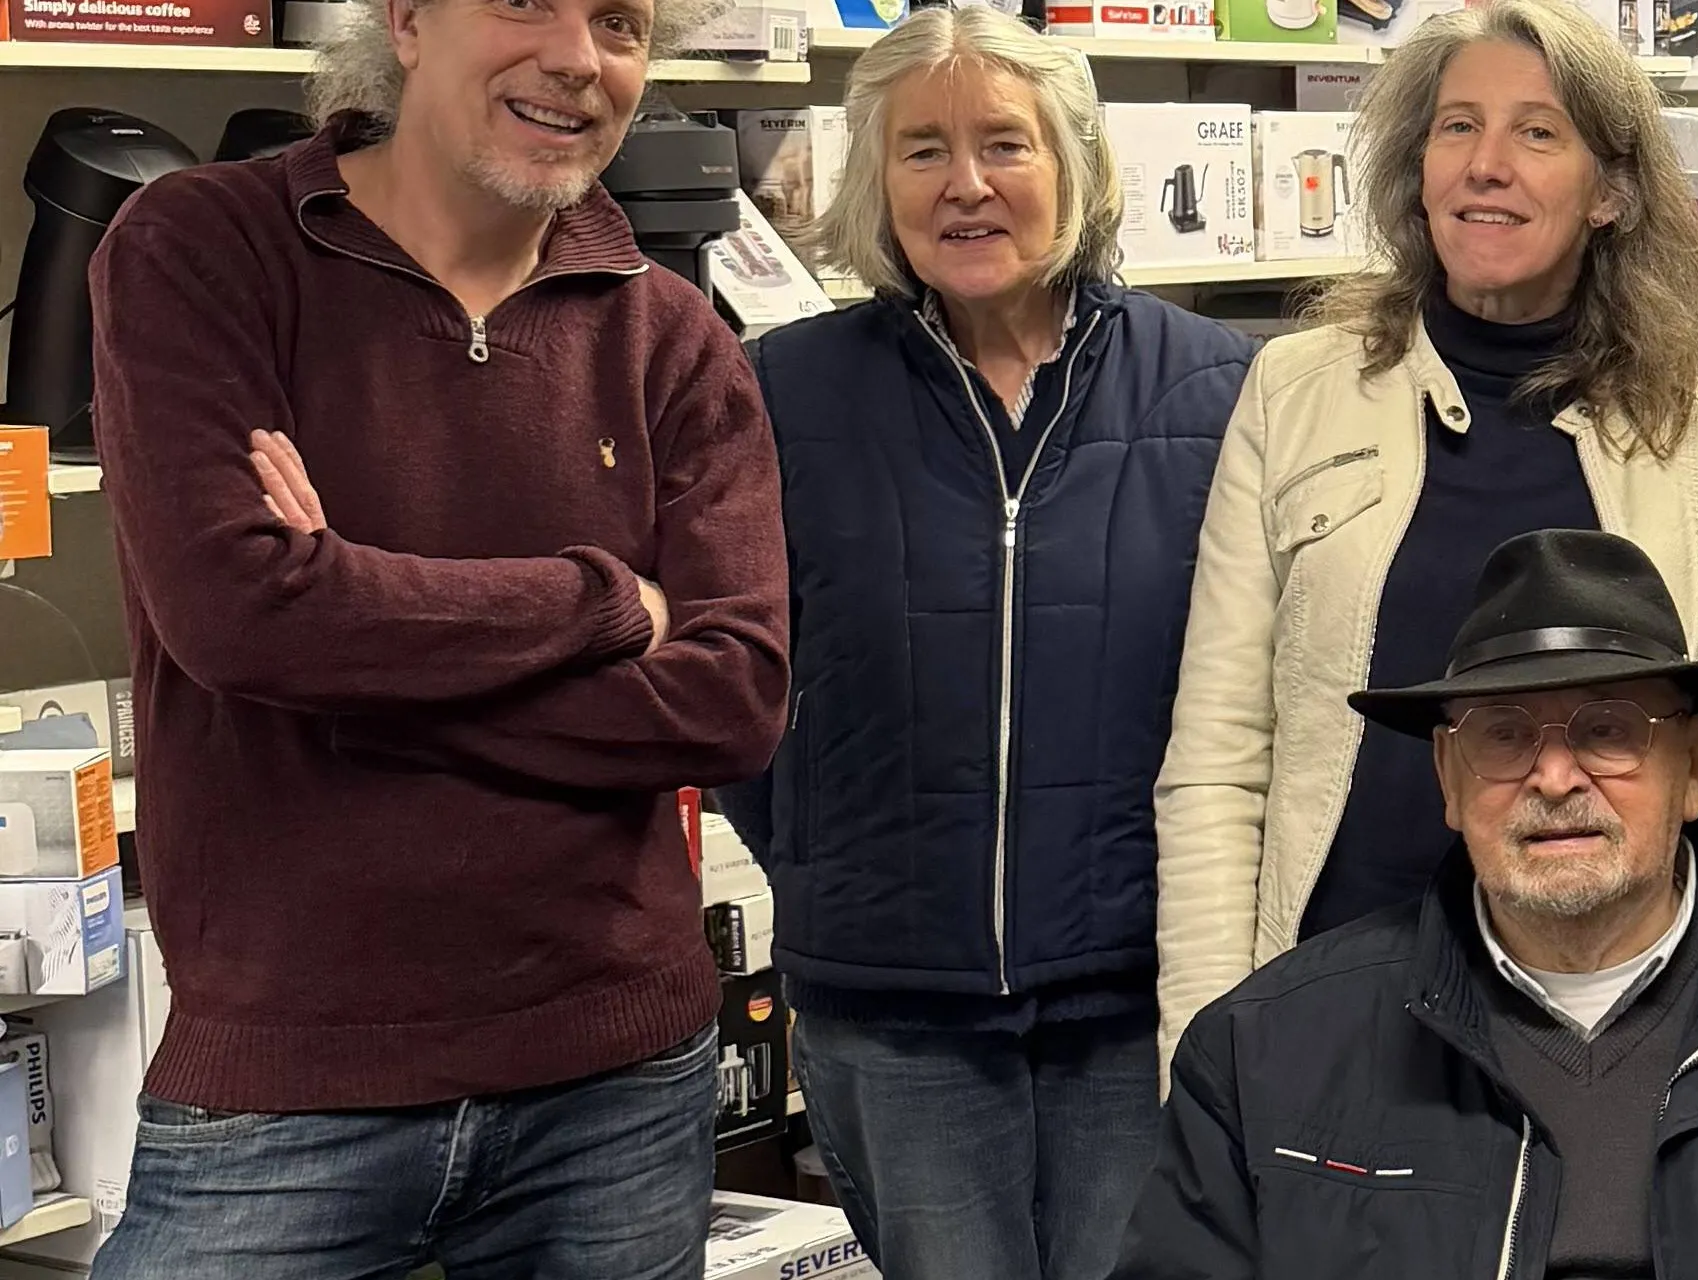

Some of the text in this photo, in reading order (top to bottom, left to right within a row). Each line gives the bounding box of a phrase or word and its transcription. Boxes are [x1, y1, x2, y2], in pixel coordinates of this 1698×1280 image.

[24, 0, 191, 18] Simply delicious coffee
[1307, 74, 1361, 84] INVENTUM
[760, 119, 806, 129] SEVERIN
[117, 700, 134, 758] PRINCESS
[25, 1042, 47, 1126] PHILIPS
